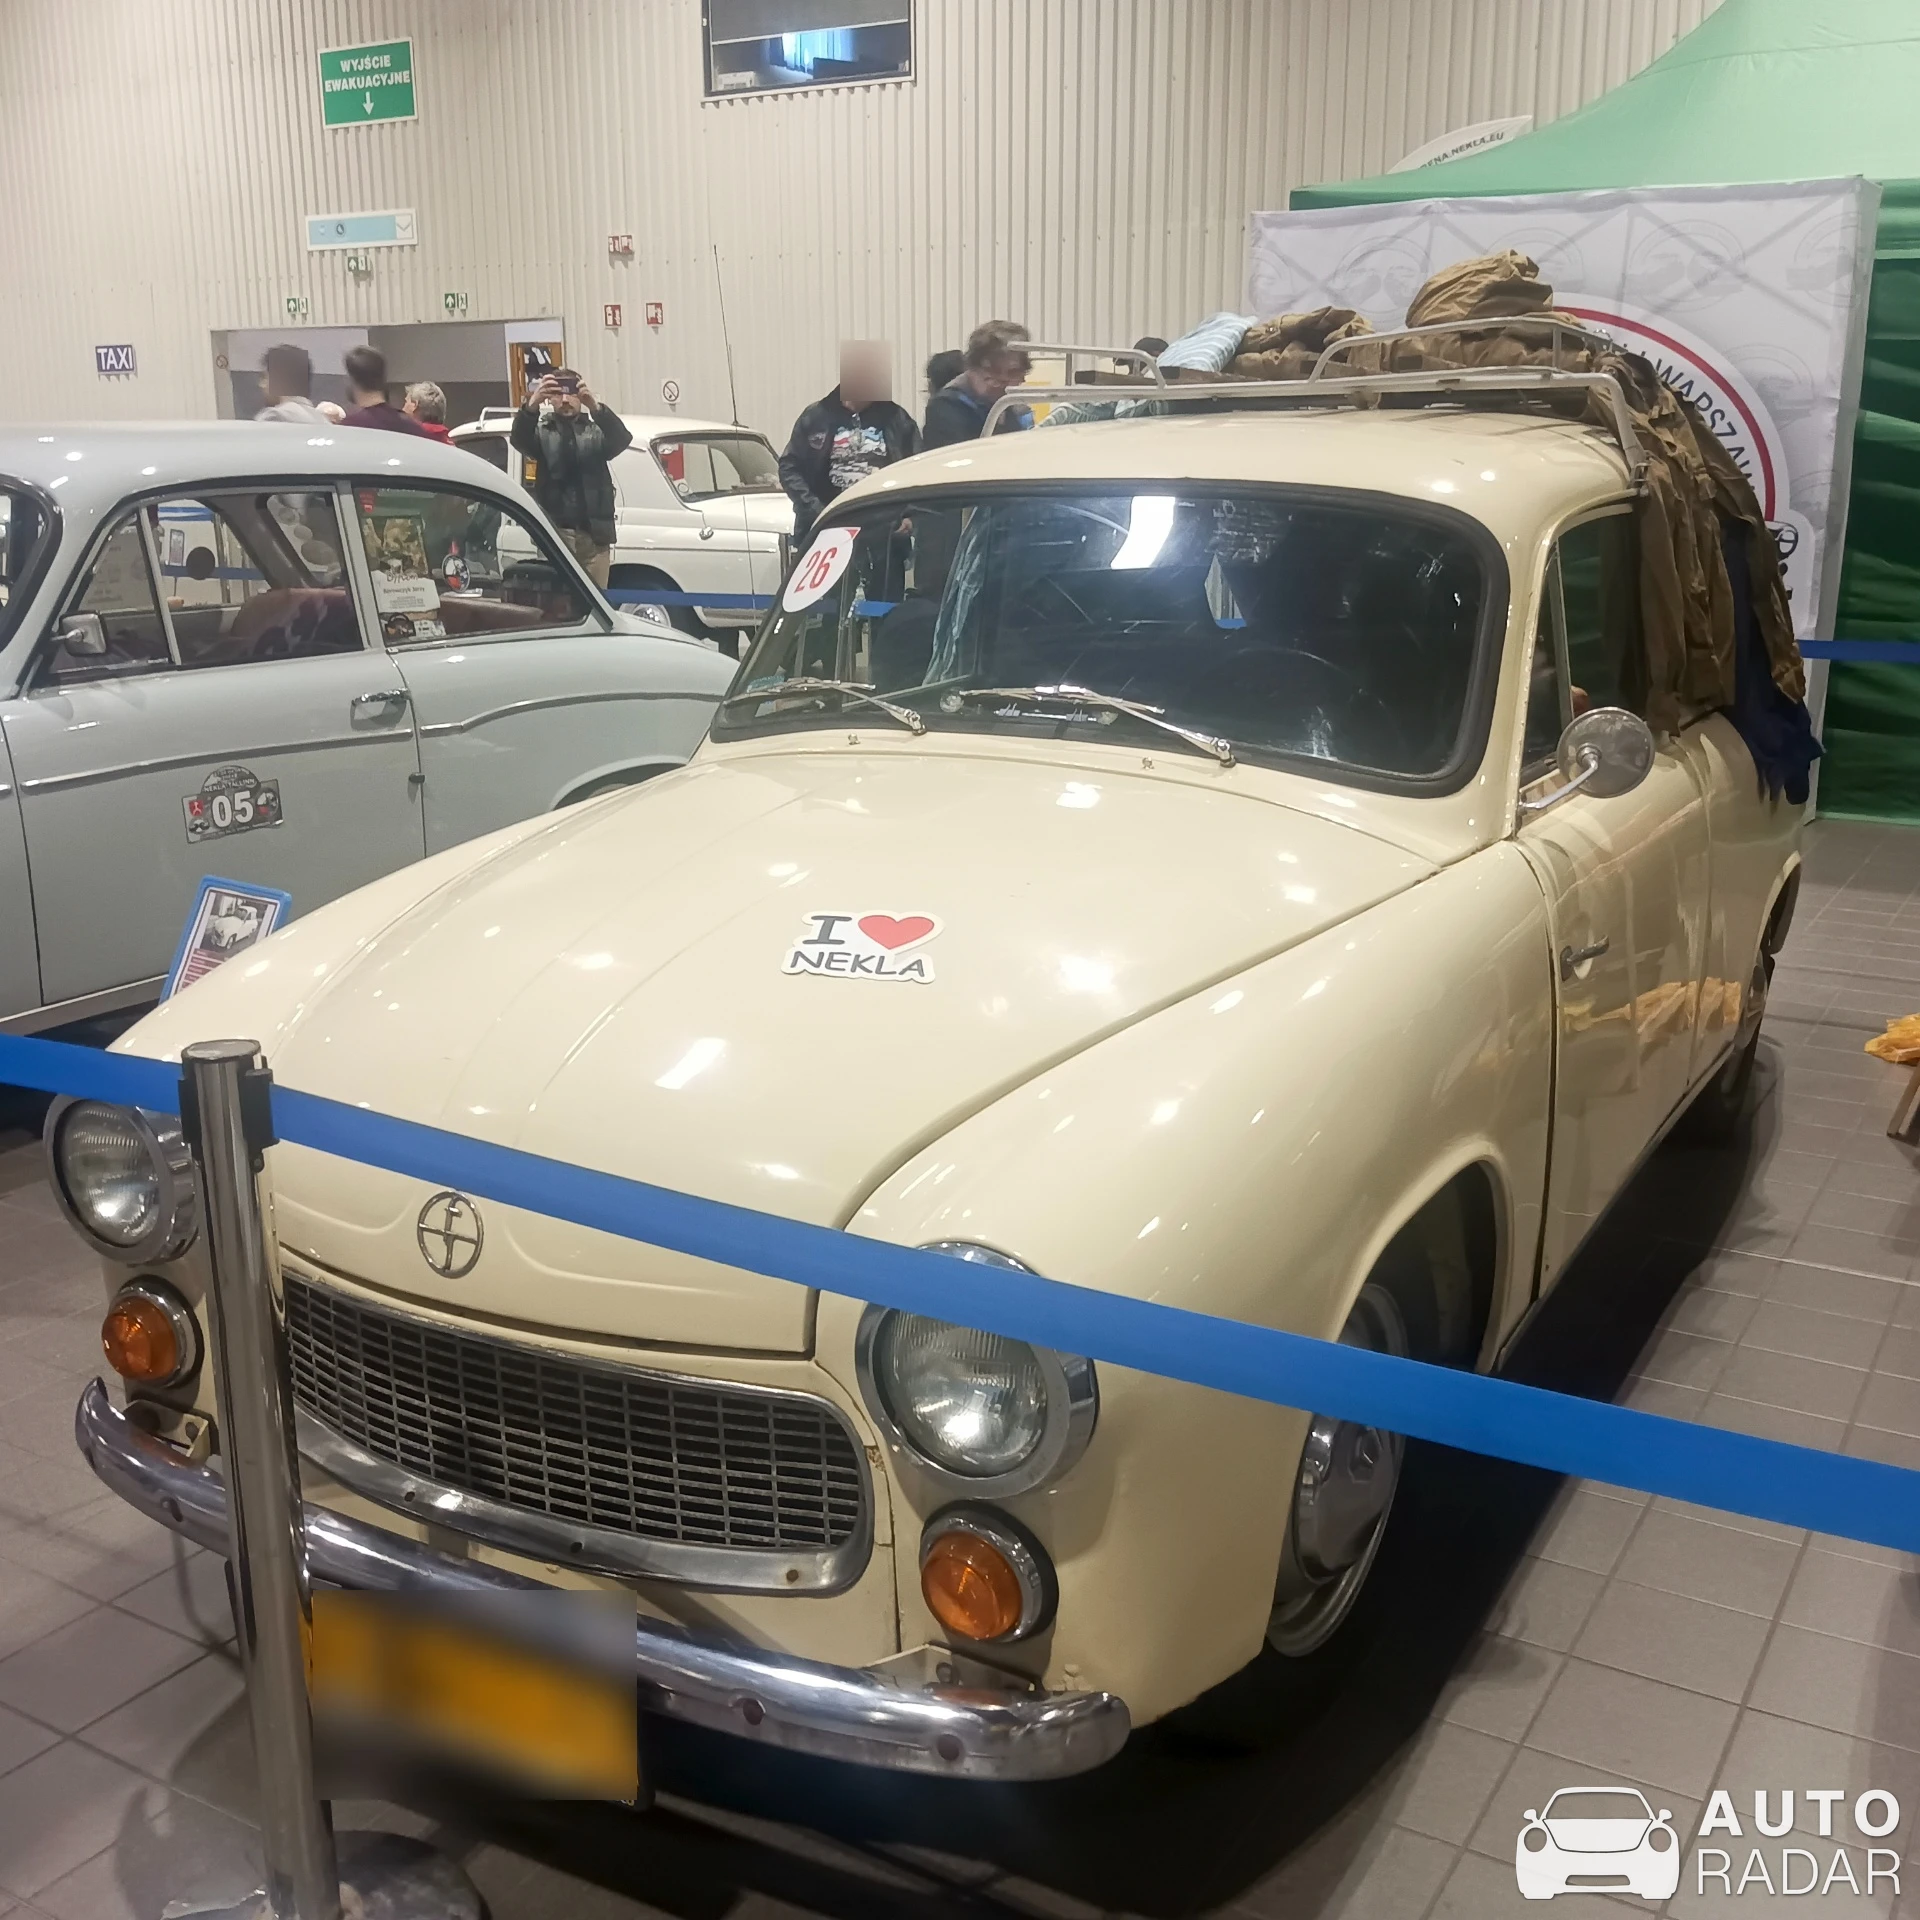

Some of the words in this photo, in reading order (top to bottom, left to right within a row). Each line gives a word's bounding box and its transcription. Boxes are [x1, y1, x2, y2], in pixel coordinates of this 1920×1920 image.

[340, 54, 391, 72] WYJŚCIE
[324, 70, 411, 92] EWAKUACYJNE
[97, 347, 133, 370] TAXI
[794, 547, 838, 593] 26
[211, 790, 254, 828] 05
[802, 915, 852, 945] I
[790, 950, 925, 977] NEKLA
